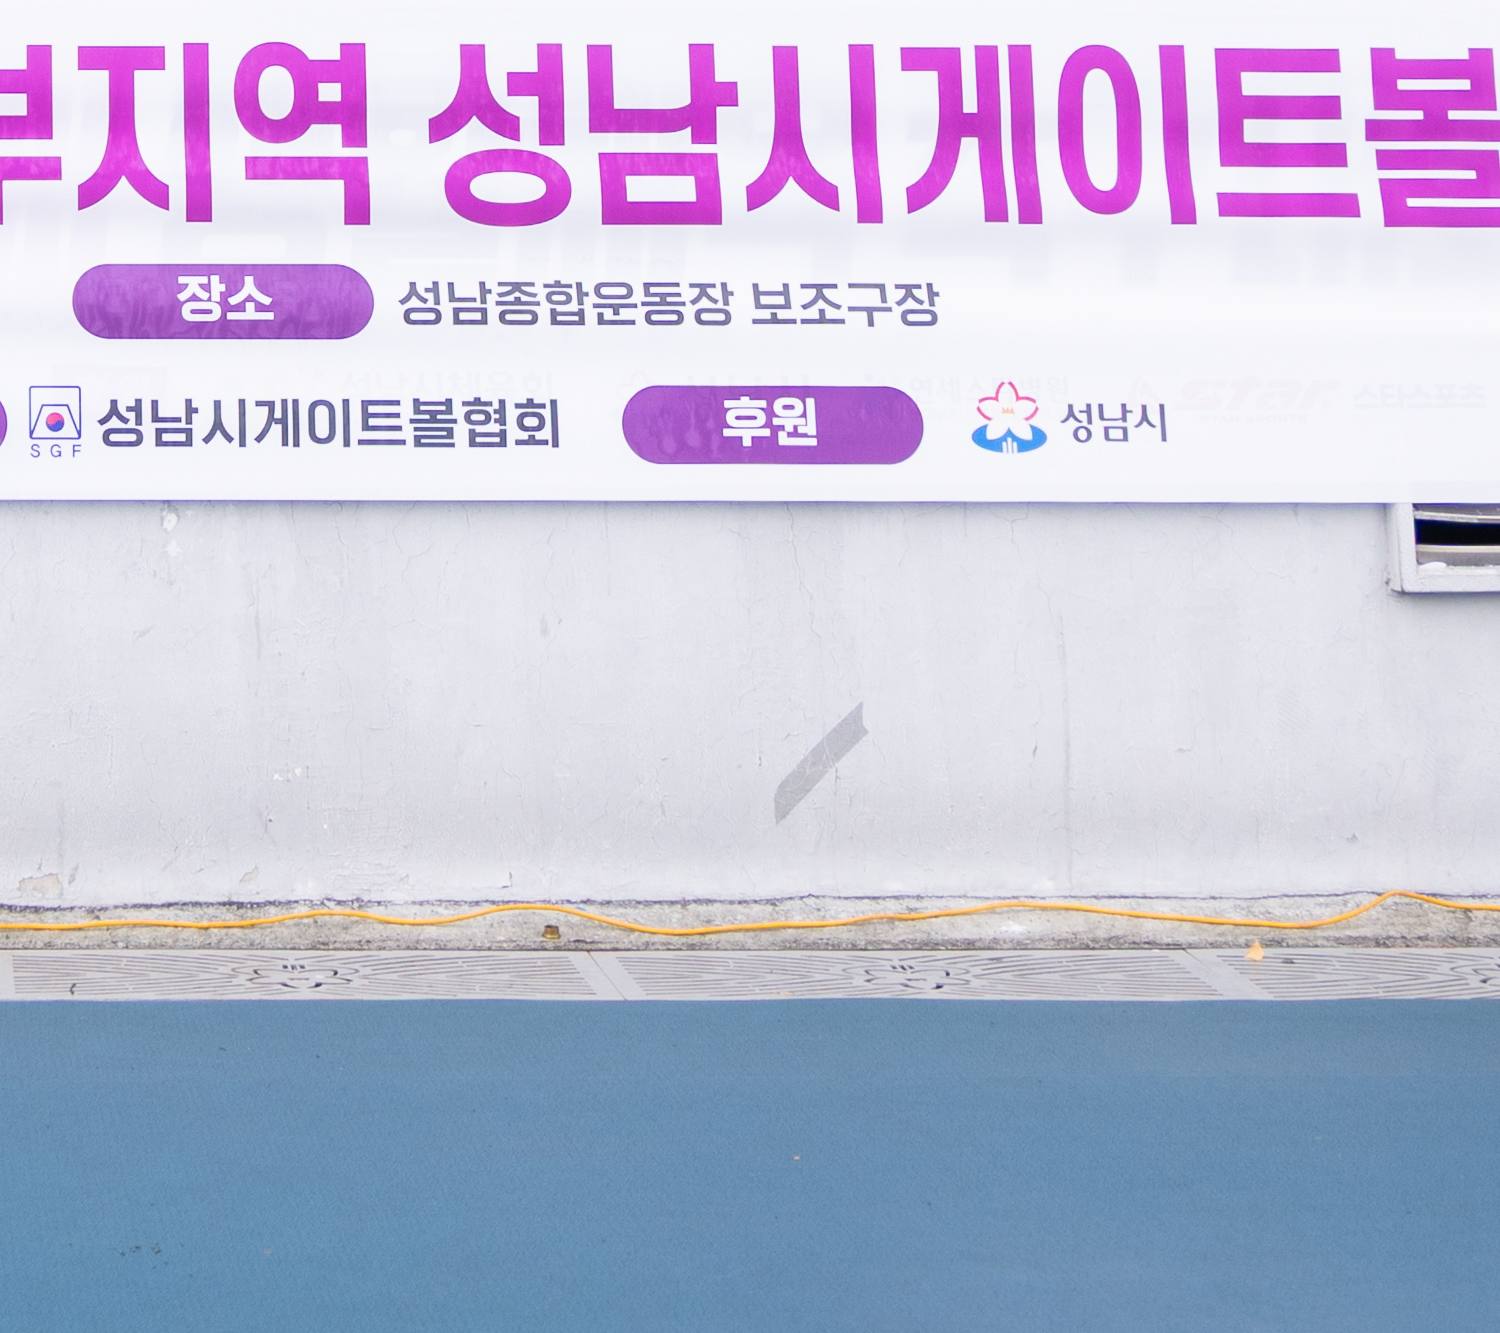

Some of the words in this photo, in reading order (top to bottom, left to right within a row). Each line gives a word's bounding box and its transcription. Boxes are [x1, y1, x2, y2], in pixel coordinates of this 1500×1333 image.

[175, 274, 276, 324] 장소
[399, 279, 735, 327] 성남종합운동장
[750, 281, 941, 328] 보조구장
[96, 395, 561, 449] 성남시게이트볼협회
[722, 395, 818, 448] 후원
[1060, 401, 1168, 445] 성남시
[29, 444, 83, 458] SGF
